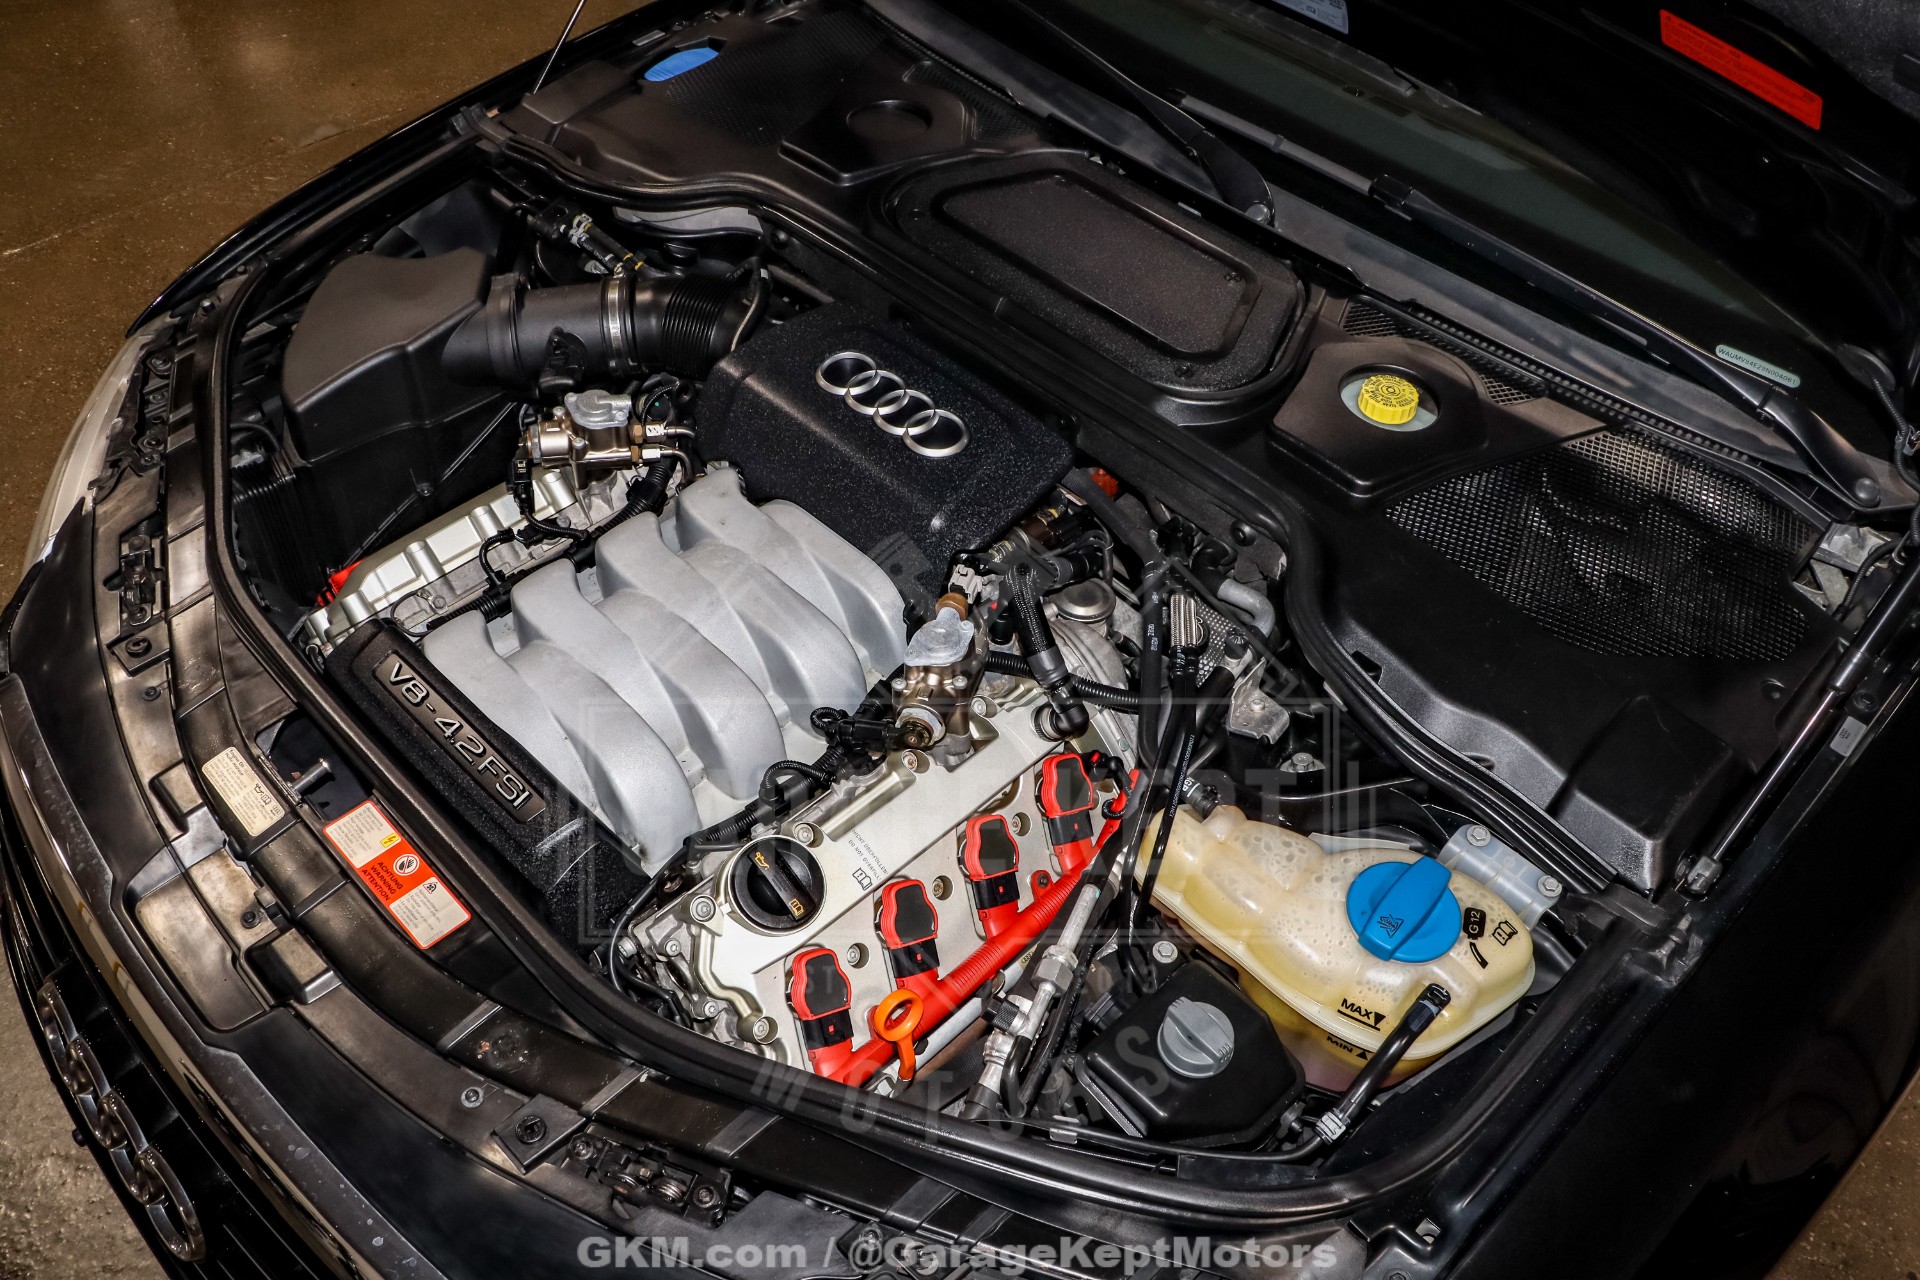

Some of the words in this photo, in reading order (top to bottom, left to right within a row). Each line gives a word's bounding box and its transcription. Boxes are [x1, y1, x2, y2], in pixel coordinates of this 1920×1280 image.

[362, 869, 390, 901] ATTENTION
[370, 865, 397, 895] WARNING
[377, 861, 404, 890] ACHTUNG
[1341, 998, 1373, 1021] MAX
[1326, 1035, 1353, 1053] MIN
